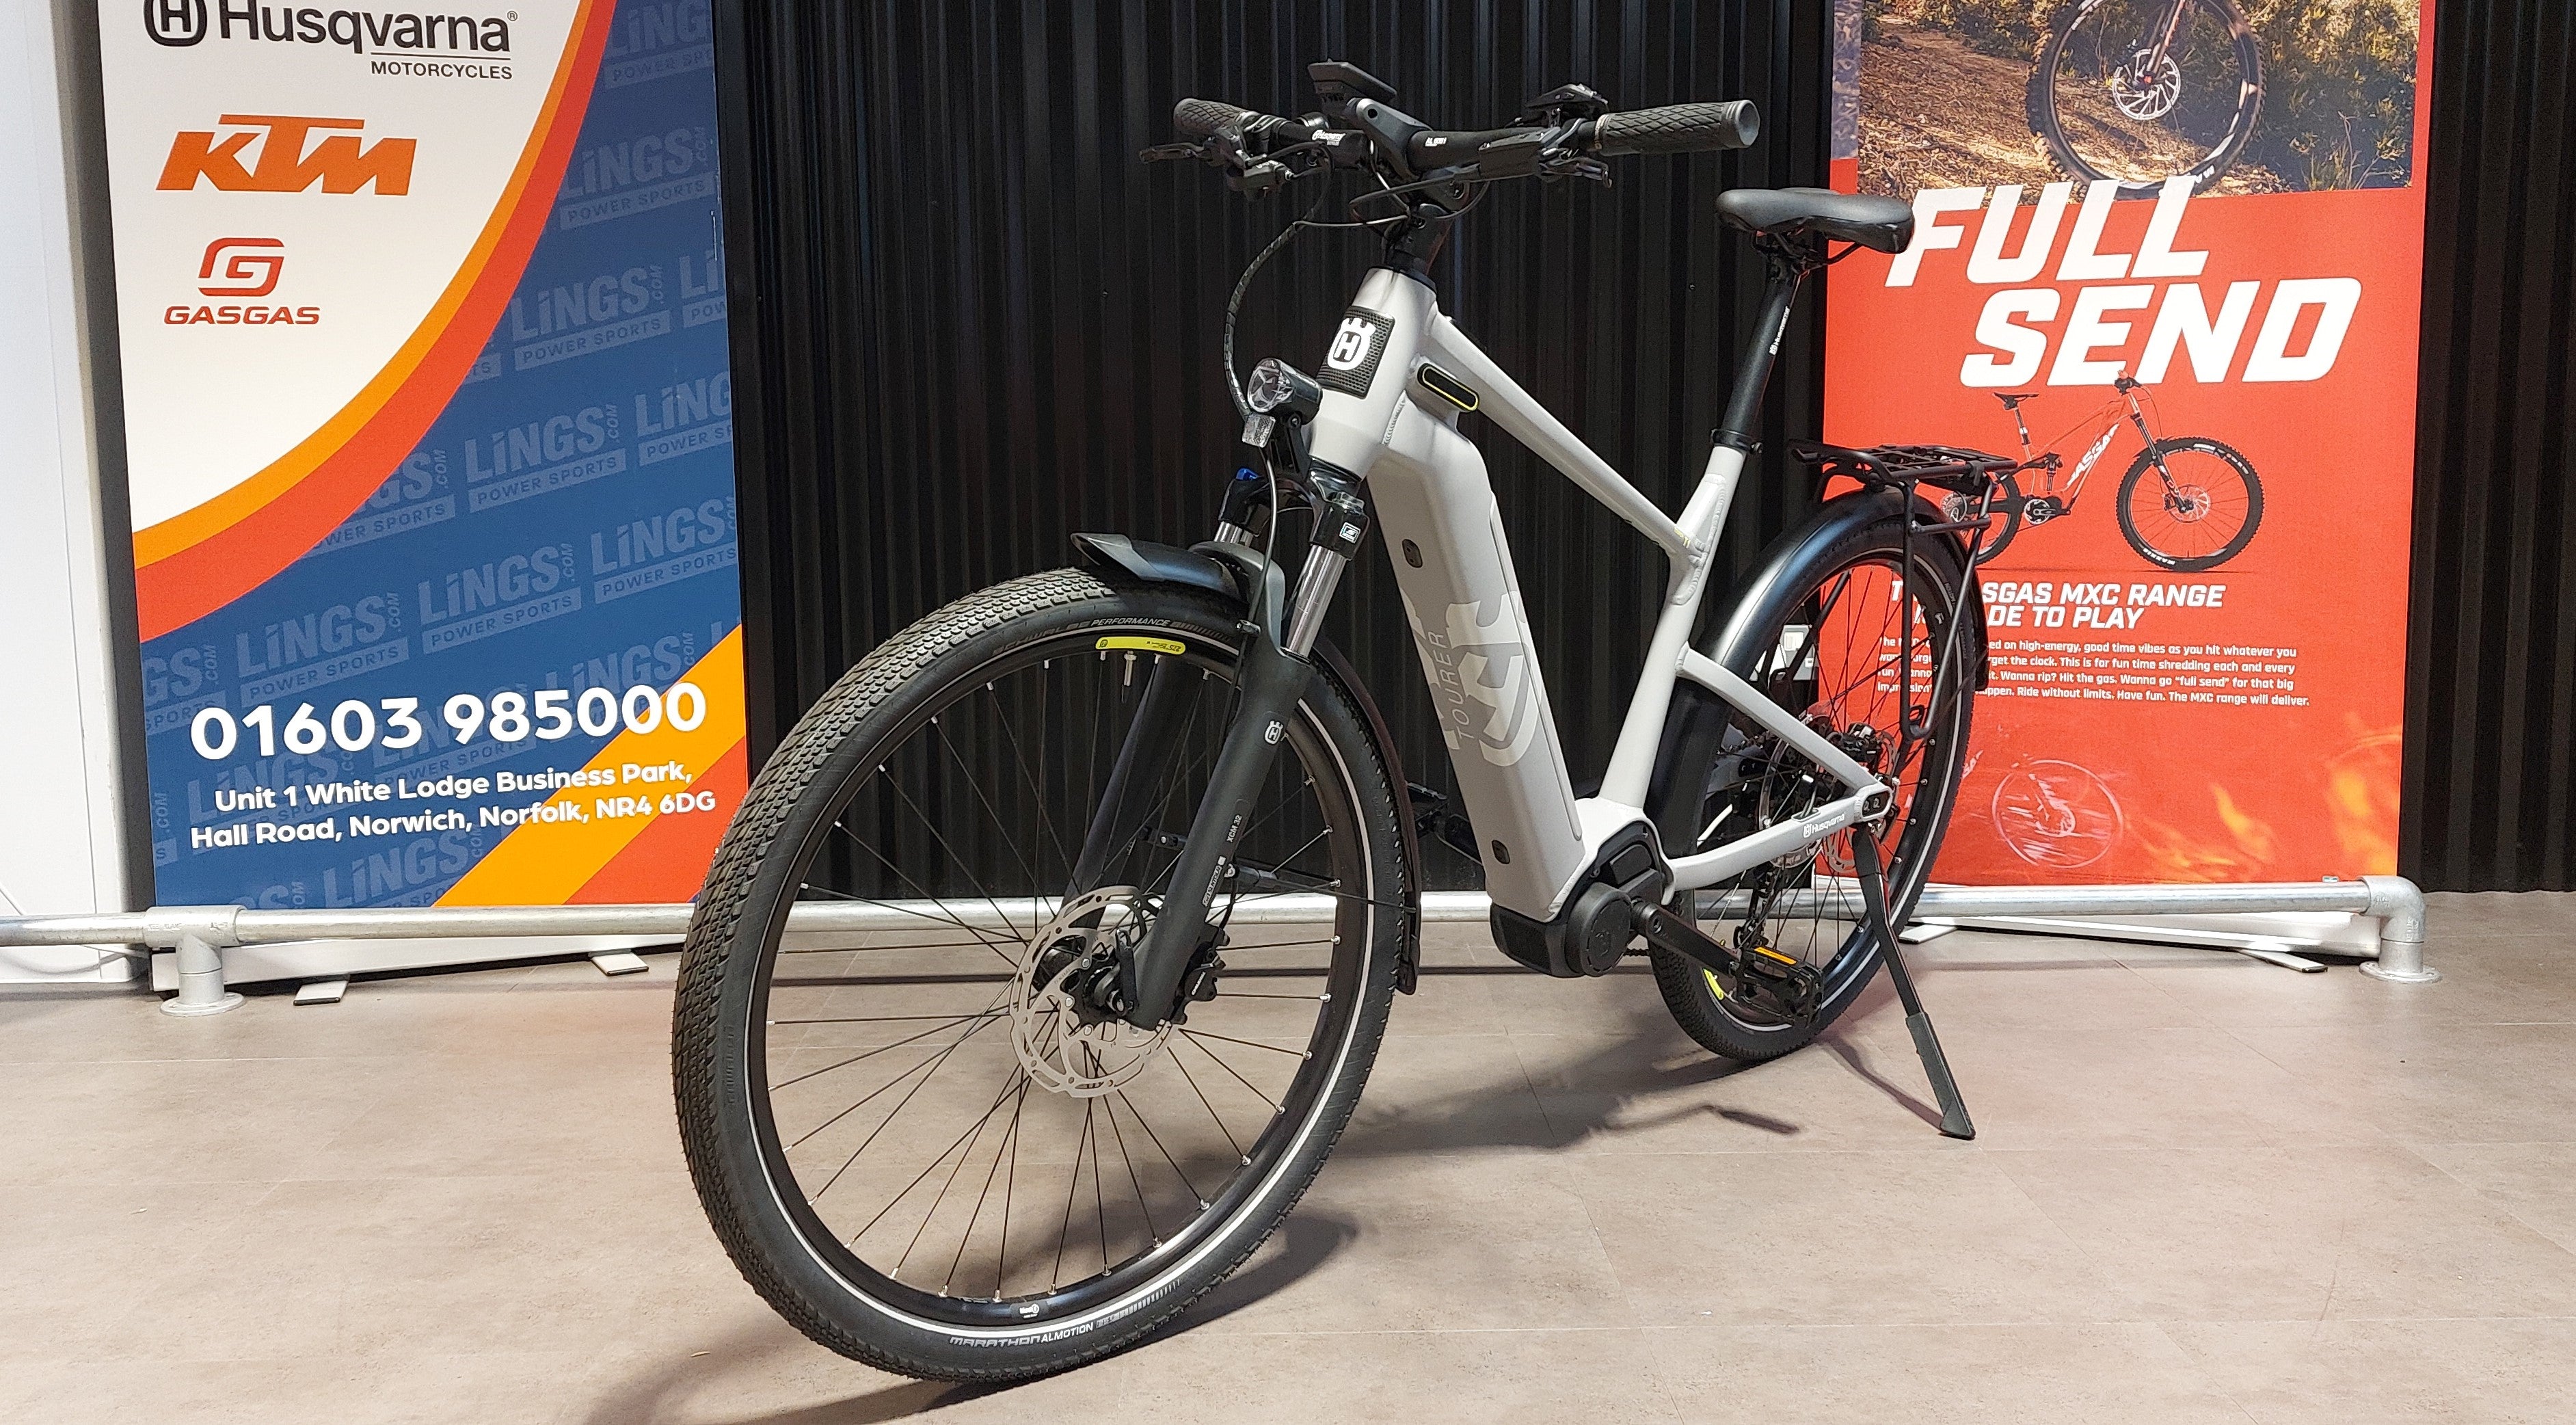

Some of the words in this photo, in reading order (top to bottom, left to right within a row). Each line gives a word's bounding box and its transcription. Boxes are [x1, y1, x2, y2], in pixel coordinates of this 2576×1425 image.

[371, 59, 513, 81] MOTORCYCLES
[613, 57, 675, 81] POWER
[156, 114, 417, 196] KTM
[567, 196, 632, 222] POWER
[638, 178, 706, 205] SPORTS
[1885, 174, 2210, 287] FULL
[649, 264, 664, 304] .COM
[163, 305, 321, 325] GASGAS
[690, 302, 726, 321] POW
[522, 336, 587, 364] POWER
[594, 318, 662, 346] SPORTS
[1959, 276, 2362, 388] SEND
[605, 403, 619, 443] .COM
[634, 370, 731, 438] LiNG
[645, 431, 709, 459] POWER
[433, 449, 449, 490] .COM
[477, 478, 542, 505] POWER
[548, 455, 617, 486] SPORTS
[373, 503, 446, 533] SPORTS
[560, 542, 576, 583] .COM
[602, 565, 665, 596] POWER
[670, 547, 736, 576] SPORTS
[386, 591, 403, 633] .COM
[1982, 582, 2053, 604] SGAS
[2060, 583, 2121, 606] MXC
[2128, 584, 2227, 608] RANGE
[431, 617, 497, 647] POWER
[503, 595, 572, 626] SPORTS
[1091, 617, 1171, 628] PERFORMANCE
[2032, 606, 2066, 628] TO
[2072, 607, 2145, 630] PLAY
[682, 630, 695, 666] COM
[2011, 656, 2028, 665] the
[2030, 655, 2057, 667] clock.
[2059, 656, 2080, 667] This
[2083, 657, 2092, 667] is
[2094, 657, 2109, 667] for
[2112, 658, 2129, 668] fun
[2132, 658, 2156, 669] time
[2158, 659, 2211, 672] shredding
[2213, 661, 2238, 672] each
[2241, 662, 2262, 673] and
[2264, 663, 2295, 675] every
[2020, 641, 2082, 653] high-energy,
[2084, 643, 2109, 653] good
[2112, 642, 2136, 652] time
[2138, 643, 2166, 654] vibes
[2169, 645, 2181, 654] as
[2183, 645, 2203, 656] you
[2205, 645, 2221, 656] hit
[2223, 645, 2274, 656] whatever
[2277, 647, 2297, 658] you
[249, 668, 319, 700] POWER
[325, 645, 399, 677] SPORTS
[1429, 630, 1475, 741] TOURER
[2000, 671, 2035, 680] Wanna
[2037, 671, 2056, 682] rip?
[2059, 673, 2074, 682] Hit
[2077, 673, 2093, 683] the
[2096, 674, 2118, 685] gas.
[2120, 674, 2156, 686] Wanna
[2159, 676, 2172, 687] go
[2232, 677, 2249, 688] for
[2251, 677, 2274, 689] that
[2277, 678, 2294, 691] big
[2017, 686, 2039, 697] Ride
[2041, 687, 2080, 698] without
[2084, 687, 2115, 700] limits.
[2117, 689, 2143, 700] Have
[2145, 690, 2166, 701] fun.
[2169, 691, 2187, 702] The
[2190, 691, 2213, 702] MXC
[2216, 693, 2247, 705] range
[2250, 693, 2268, 705] will
[2271, 694, 2310, 706] deliver.
[191, 696, 422, 761] 01603
[442, 682, 707, 745] 985000
[215, 786, 277, 812] Unit
[283, 786, 297, 807] 1
[304, 780, 392, 805] White
[398, 775, 490, 799] Lodge
[496, 767, 616, 793] Business
[623, 762, 692, 784] Park,
[191, 824, 249, 849] Hall
[256, 818, 343, 844] Road,
[349, 809, 473, 838] Norwich,
[479, 801, 589, 828] Norfolk,
[596, 797, 652, 818] NR4
[660, 791, 716, 814] 6DG
[1226, 825, 1239, 843] XCM
[1233, 814, 1243, 826] 32
[1811, 813, 1845, 834] Husqvarna
[1041, 1321, 1094, 1344] ALMOTION
